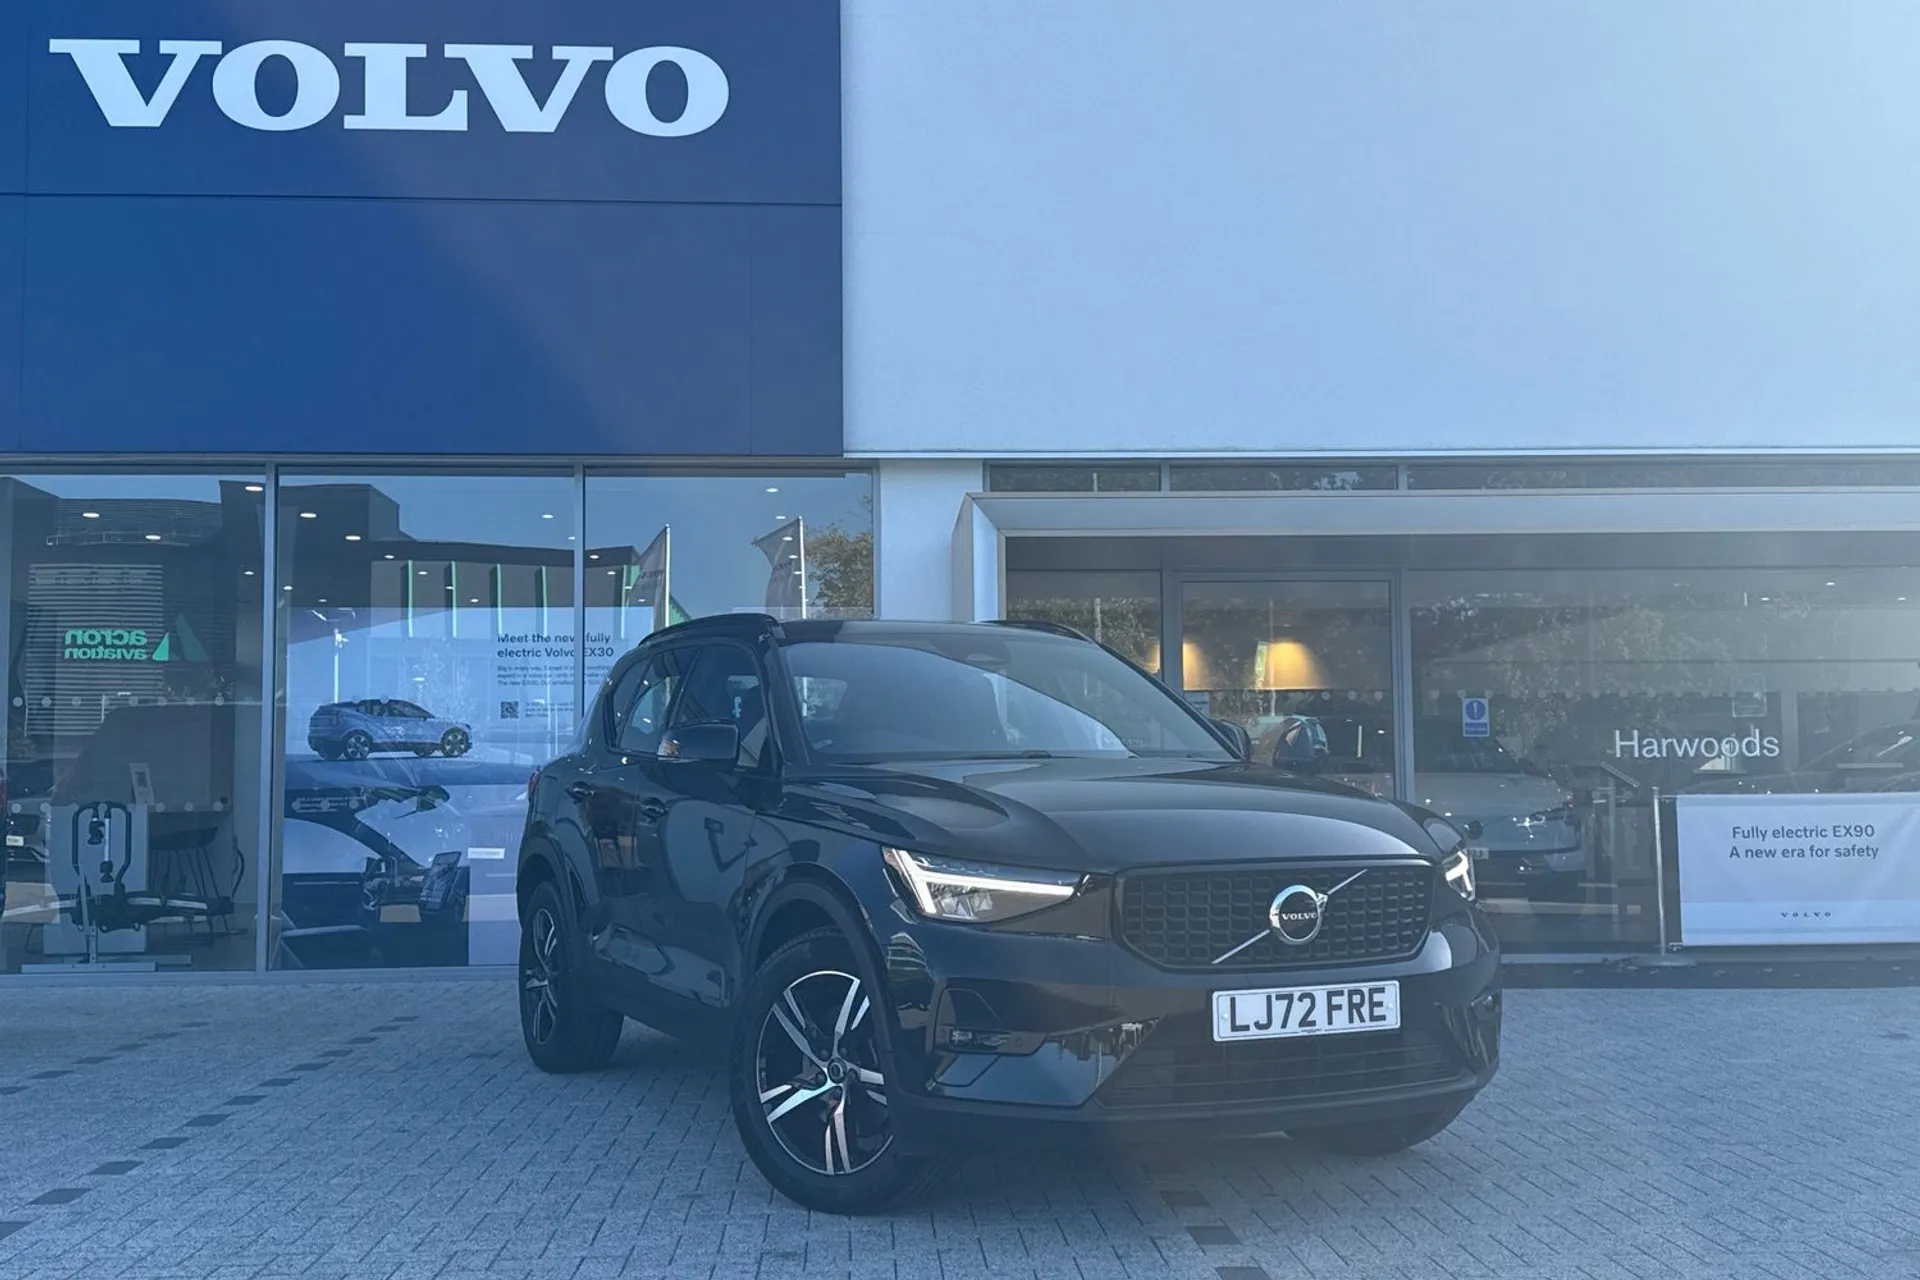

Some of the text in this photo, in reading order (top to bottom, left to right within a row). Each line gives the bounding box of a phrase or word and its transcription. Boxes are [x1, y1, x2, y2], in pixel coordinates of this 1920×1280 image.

[49, 38, 730, 137] VOLVO
[498, 633, 529, 643] Meet
[532, 633, 551, 643] the
[586, 632, 611, 644] fully
[497, 648, 541, 658] electric
[1614, 728, 1780, 758] Harwoods
[1732, 824, 1876, 842] Fully electric EX90
[1729, 844, 1879, 860] A new era for safety
[1281, 912, 1317, 920] VOLVO
[1229, 987, 1386, 1032] LJ72 FRE
